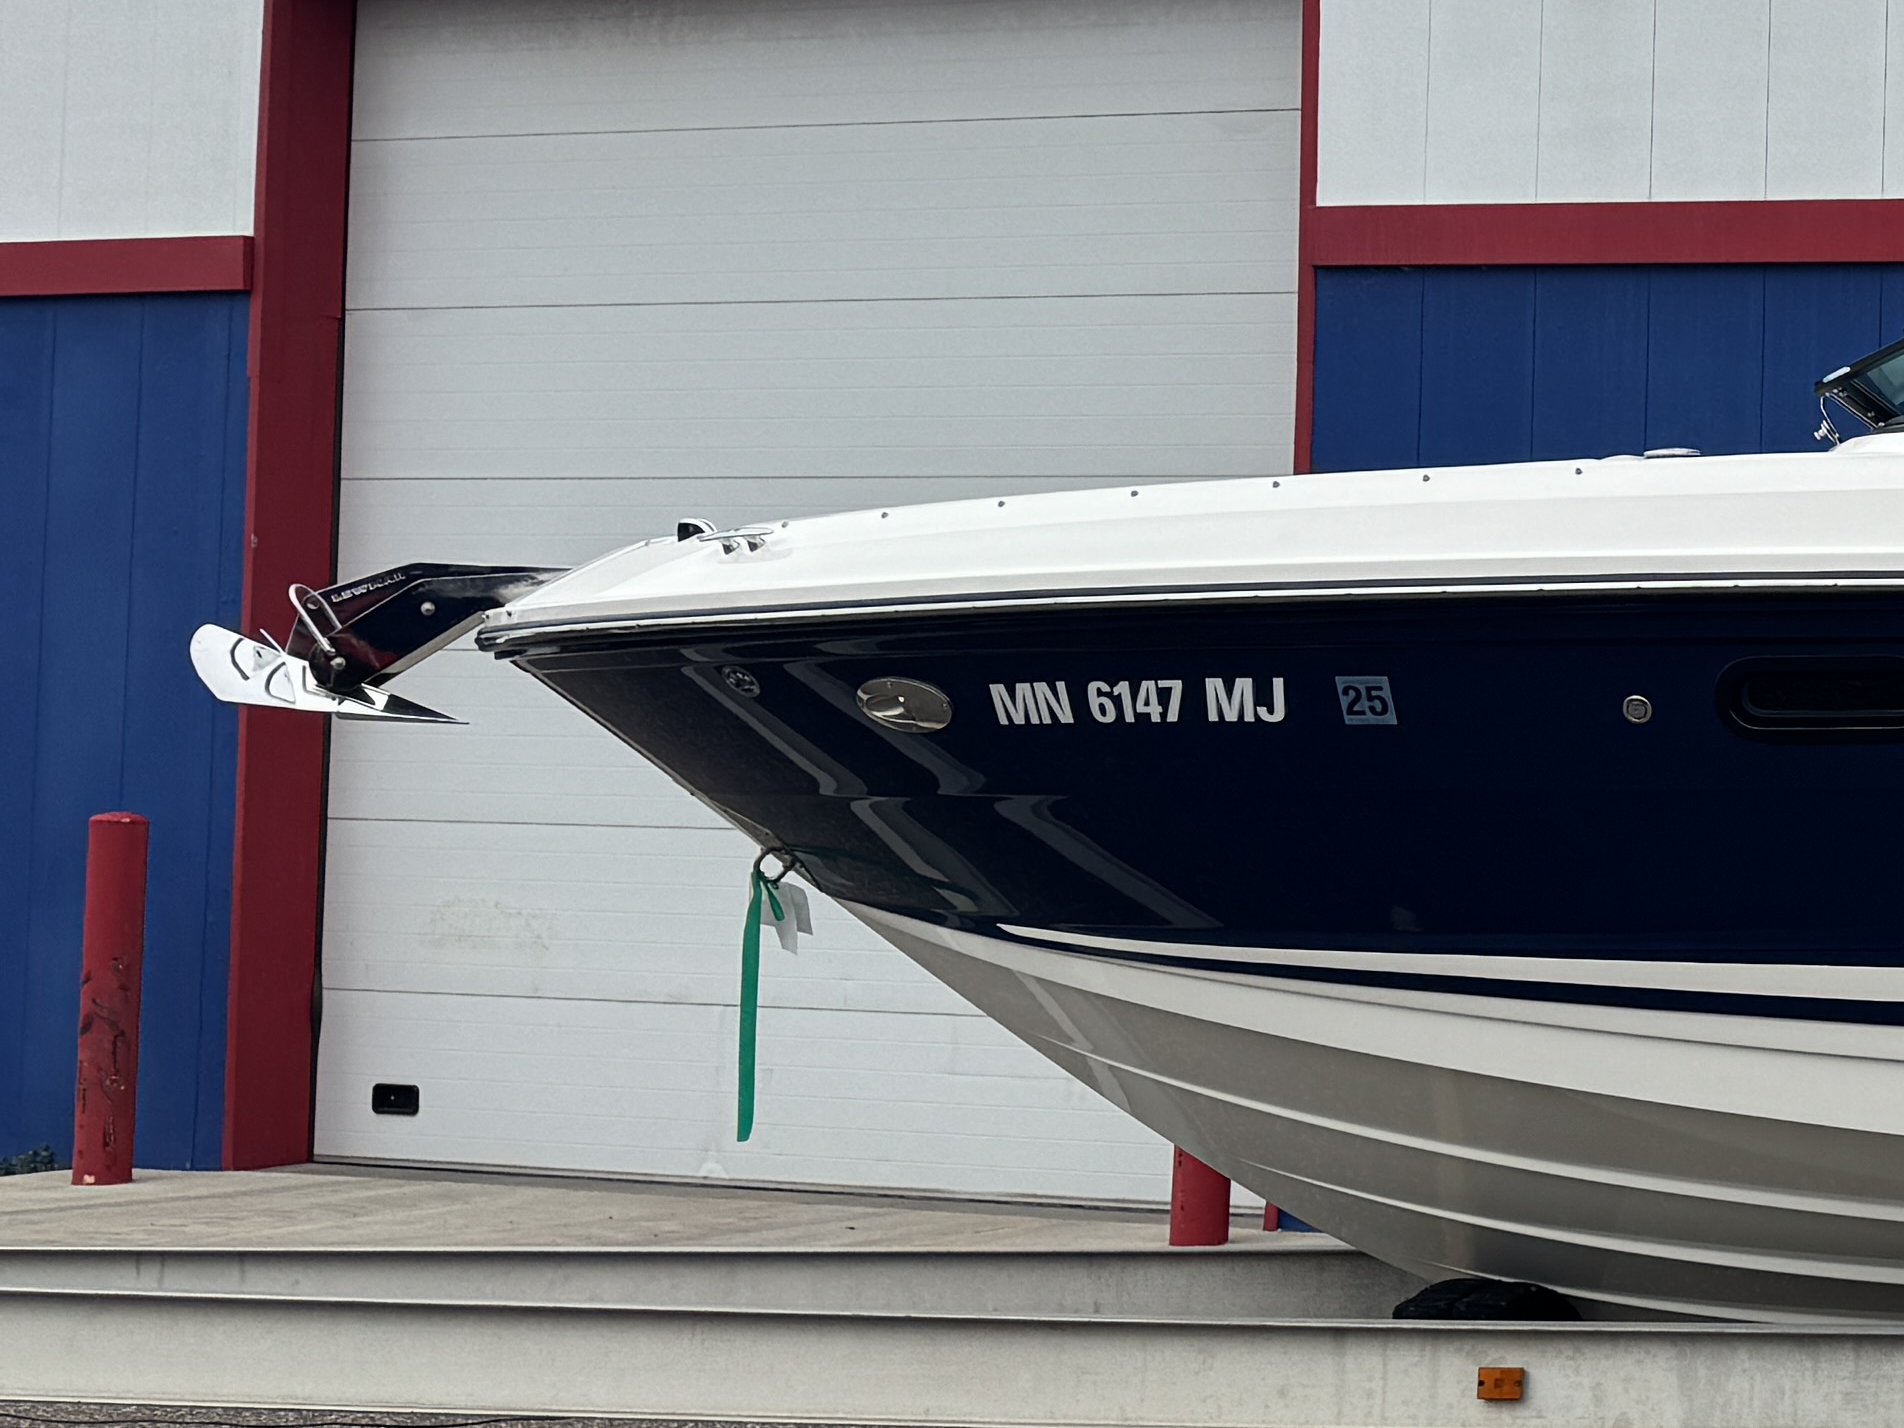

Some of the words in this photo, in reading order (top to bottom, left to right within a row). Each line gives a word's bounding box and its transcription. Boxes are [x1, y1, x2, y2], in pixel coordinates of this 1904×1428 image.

[988, 681, 1075, 726] MN
[1087, 679, 1183, 724] 6147
[1204, 677, 1286, 723] MJ
[1341, 684, 1389, 717] 25
